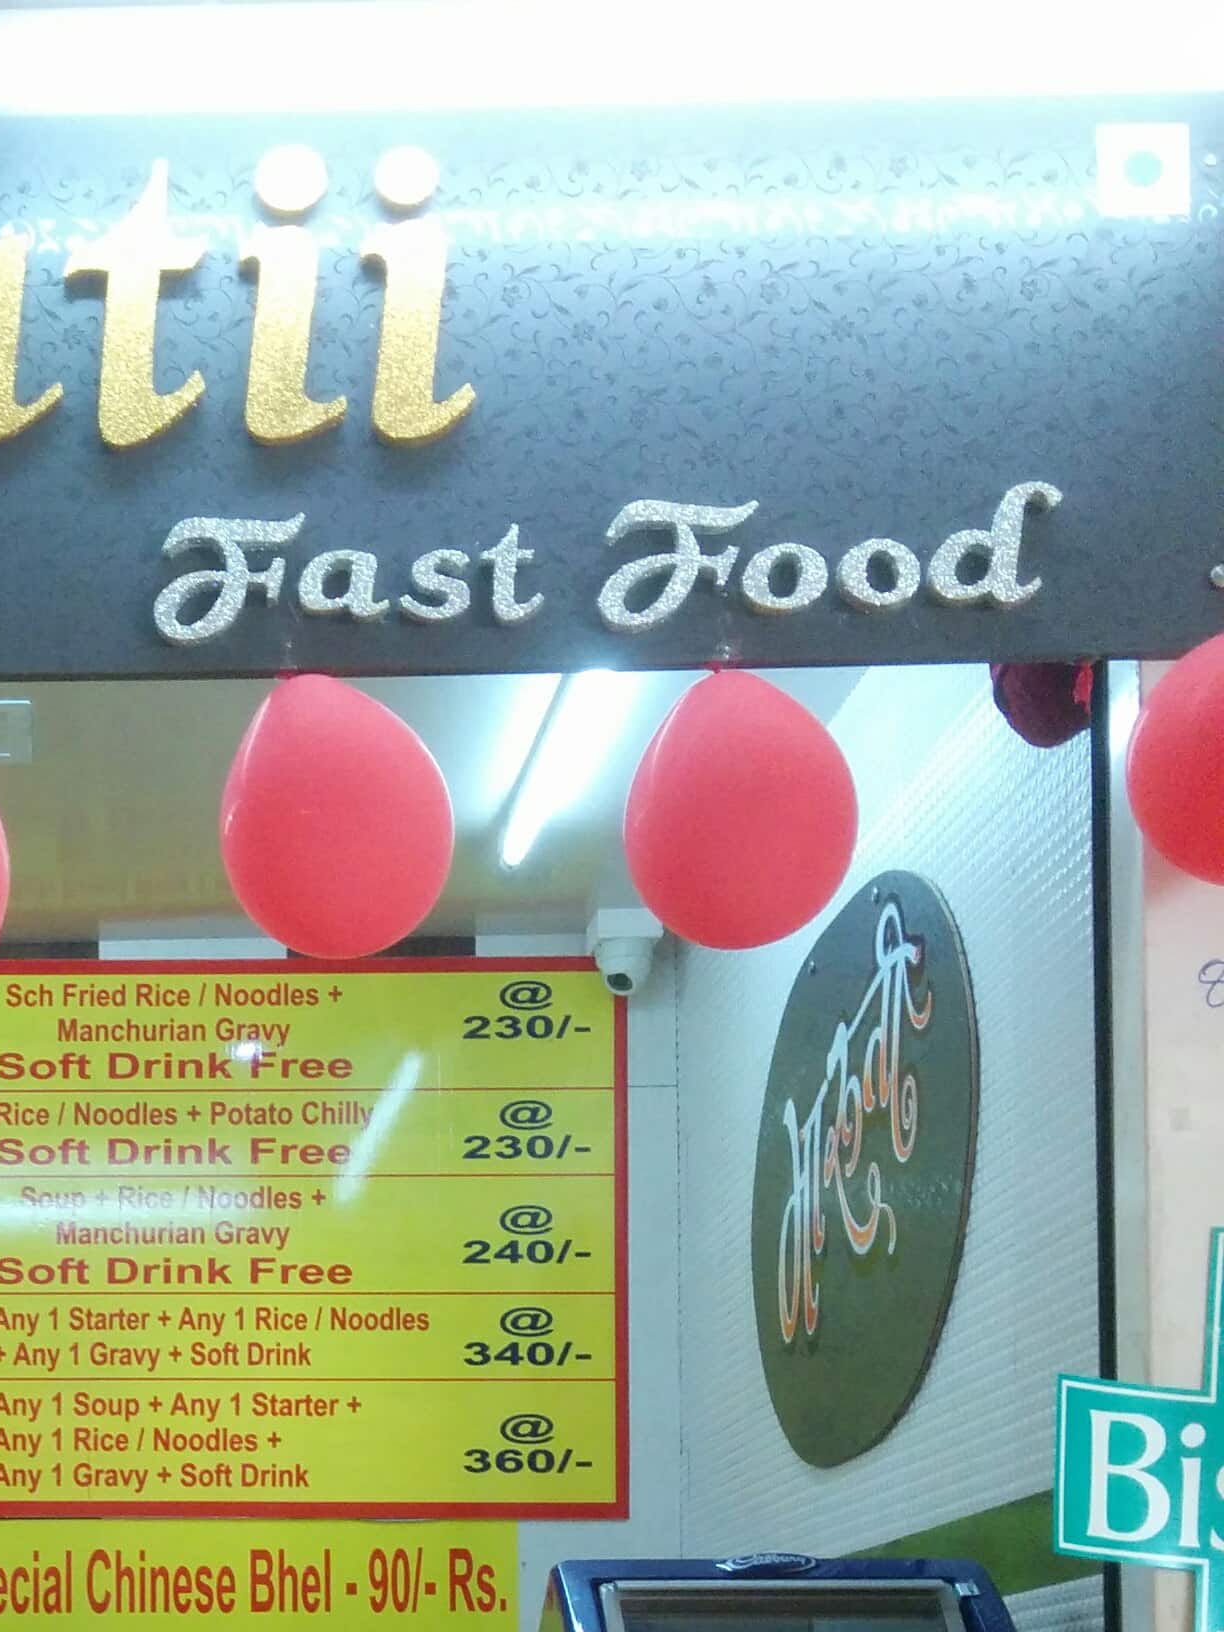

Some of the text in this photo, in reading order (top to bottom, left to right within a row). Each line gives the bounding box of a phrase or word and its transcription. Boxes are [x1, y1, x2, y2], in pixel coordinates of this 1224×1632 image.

[152, 480, 1063, 646] Fast Food
[6, 983, 345, 1009] Sch Fried Rice / Noodles +
[500, 981, 554, 1013] @
[58, 1018, 292, 1049] Manchurian Gravy
[463, 1015, 593, 1041] 230/-
[109, 1052, 234, 1081] Drink
[251, 1052, 355, 1081] Free
[58, 1103, 67, 1127] /
[74, 1102, 179, 1127] Noodles
[187, 1105, 203, 1123] +
[211, 1102, 294, 1127] Potato
[302, 1101, 375, 1132] Chilly
[499, 1100, 554, 1132] @
[108, 1137, 233, 1167] Drink
[251, 1137, 354, 1167] Free
[462, 1135, 593, 1161] 230/-
[20, 1186, 328, 1216] Soup + Rice / Noodles +
[500, 1205, 554, 1237] @
[56, 1221, 292, 1253] Manchurian Gravy
[463, 1240, 593, 1266] 240/-
[107, 1257, 234, 1286] Drink
[250, 1257, 354, 1286] Free
[49, 1307, 60, 1332] 1
[69, 1307, 152, 1333] Starter
[158, 1311, 173, 1328] +
[179, 1307, 227, 1339] Any
[235, 1307, 245, 1332] 1
[256, 1307, 309, 1332] Rice
[315, 1307, 324, 1332] /
[331, 1307, 431, 1333] Noodles
[500, 1307, 555, 1339] @
[13, 1342, 62, 1373] Any
[70, 1343, 80, 1367] 1
[90, 1342, 162, 1373] Gravy
[168, 1346, 184, 1364] +
[191, 1342, 241, 1368] Soft
[248, 1342, 313, 1368] Drink
[464, 1342, 594, 1368] 340/-
[52, 1392, 63, 1418] 1
[74, 1392, 141, 1424] Soup
[149, 1396, 164, 1414] +
[170, 1392, 222, 1424] Any
[231, 1392, 242, 1418] 1
[252, 1392, 341, 1418] Starter
[347, 1396, 363, 1415] +
[52, 1428, 63, 1453] 1
[74, 1427, 130, 1453] Rice
[137, 1428, 146, 1453] /
[154, 1428, 260, 1454] Noodles
[267, 1432, 283, 1450] +
[500, 1414, 556, 1446] @
[464, 1449, 594, 1475] 360/-
[52, 1463, 63, 1488] 1
[74, 1463, 150, 1495] Gravy
[157, 1467, 173, 1485] +
[181, 1463, 234, 1489] Soft
[241, 1463, 311, 1489] Drink
[1086, 1409, 1223, 1552] Bi
[87, 1549, 238, 1616] Chinese
[250, 1549, 333, 1615] Bhel
[346, 1583, 359, 1597] -
[369, 1548, 438, 1615] 90/-
[449, 1548, 508, 1614] Rs.
